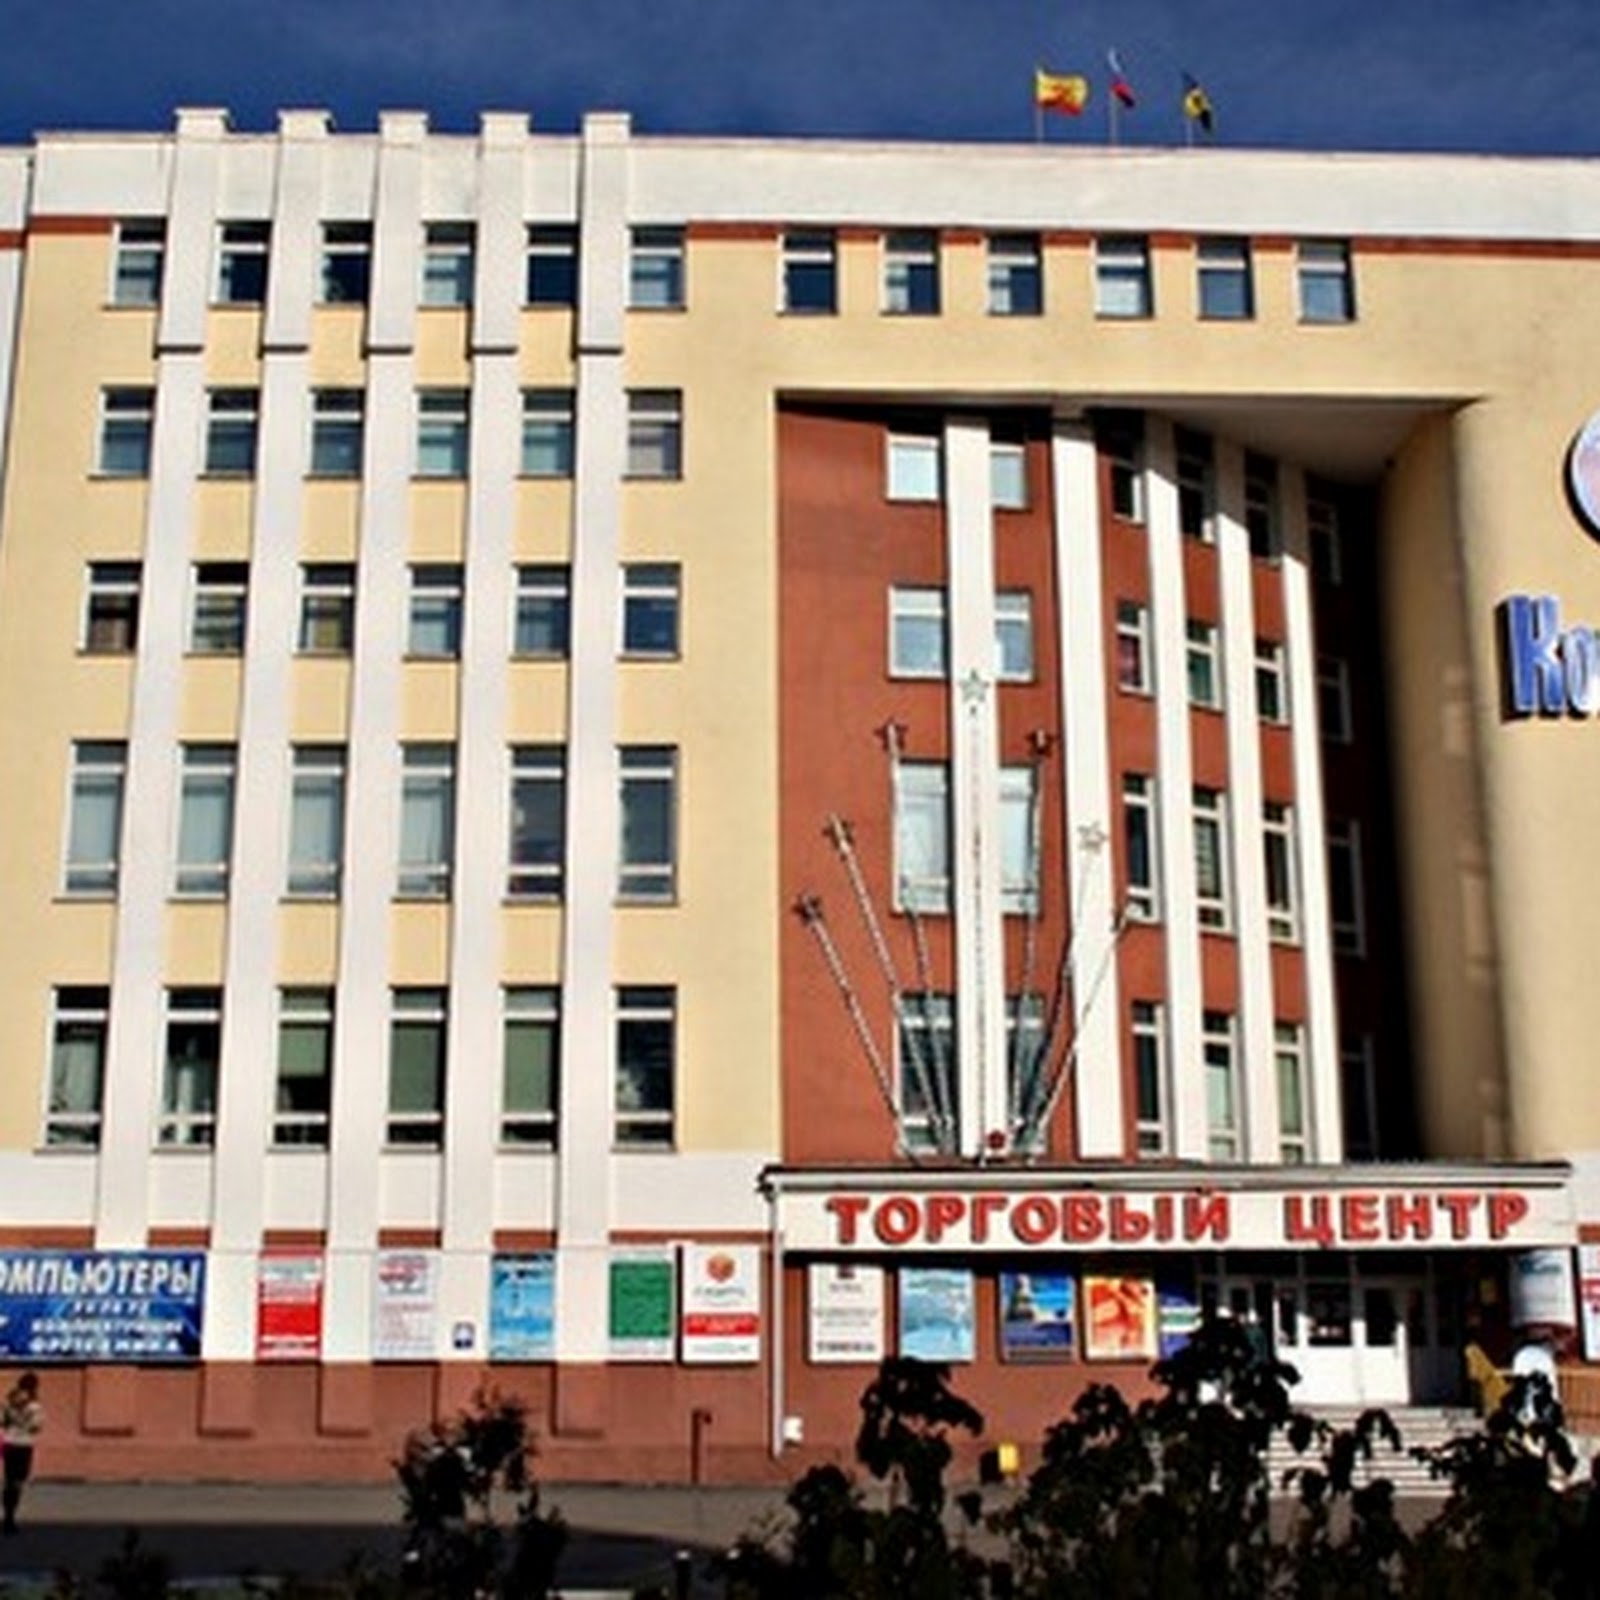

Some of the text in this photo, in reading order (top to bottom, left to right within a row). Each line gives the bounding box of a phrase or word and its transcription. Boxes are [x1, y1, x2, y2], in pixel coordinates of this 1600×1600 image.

[1503, 595, 1600, 716] Ко
[825, 1184, 1529, 1247] ТОРГОВЫЙ ЦЕНТР
